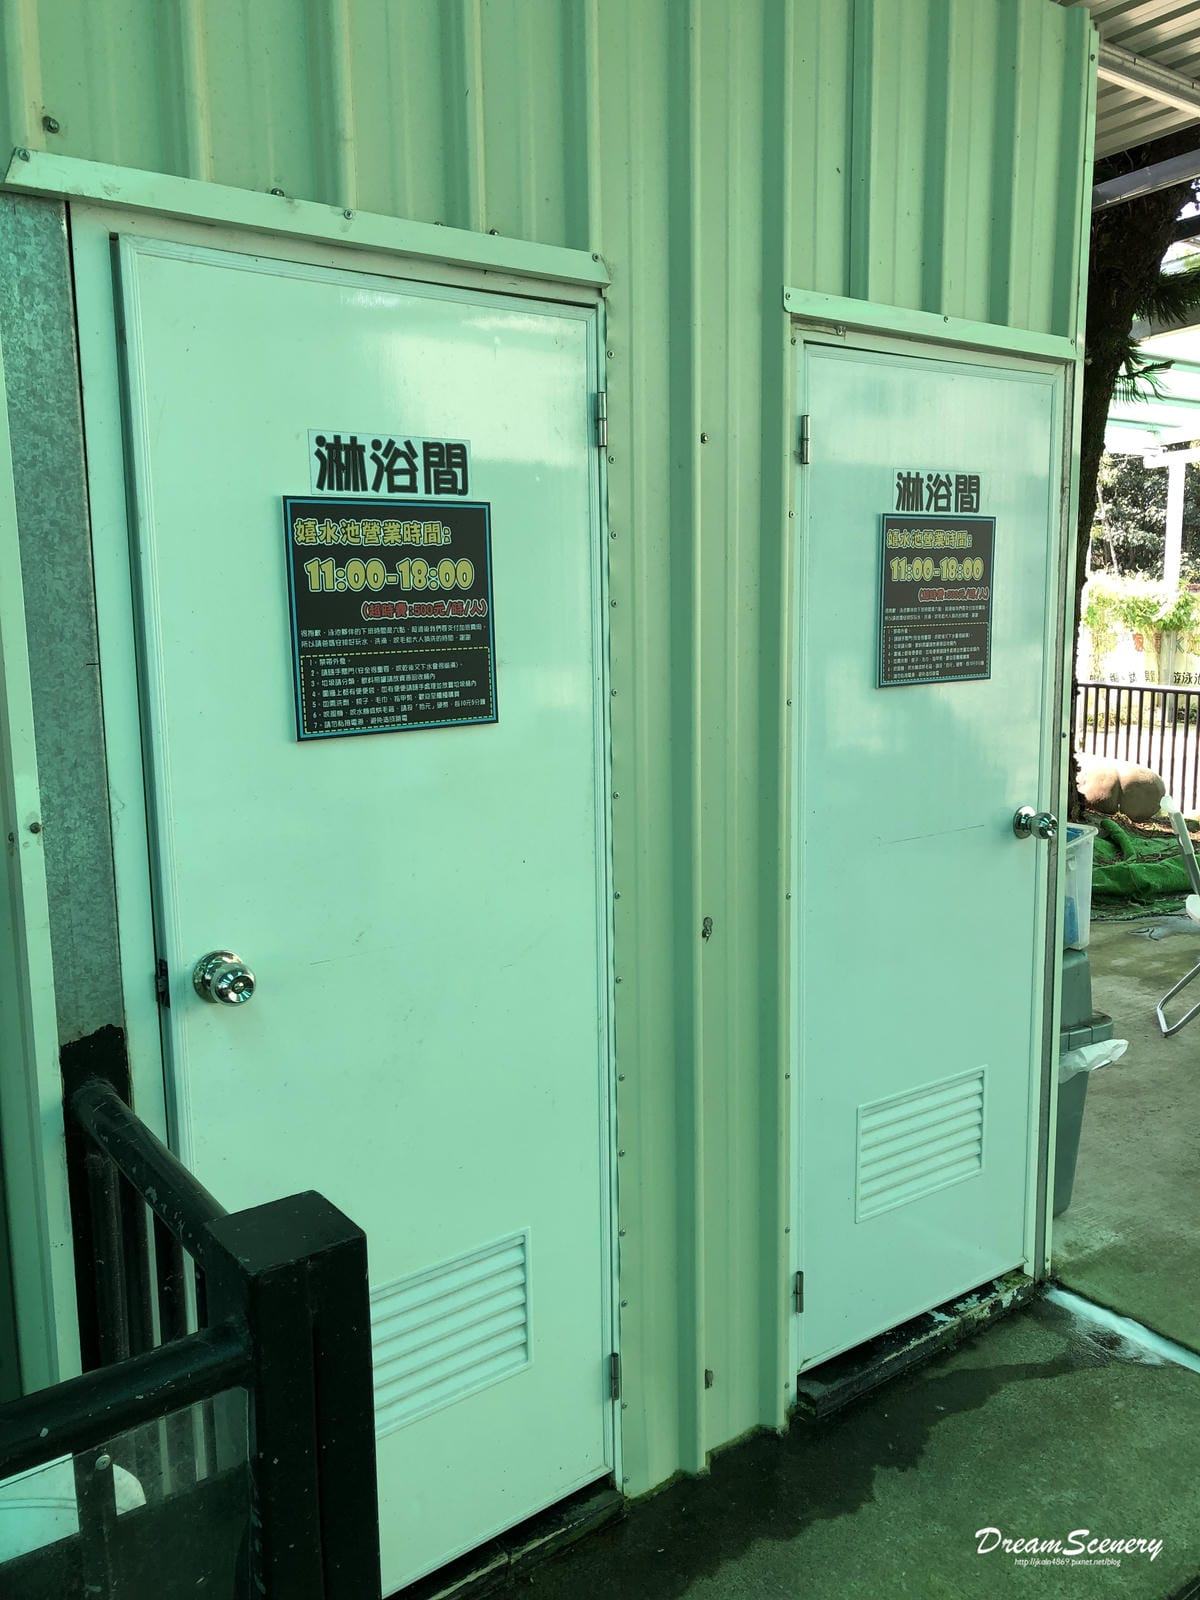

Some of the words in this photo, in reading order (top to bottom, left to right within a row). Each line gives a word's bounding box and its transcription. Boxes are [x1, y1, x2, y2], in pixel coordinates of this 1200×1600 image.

[313, 434, 468, 497] 淋浴間
[895, 471, 981, 513] 淋浴間
[303, 557, 475, 593] 11:00-18:00
[889, 556, 984, 582] 11:00-18:00
